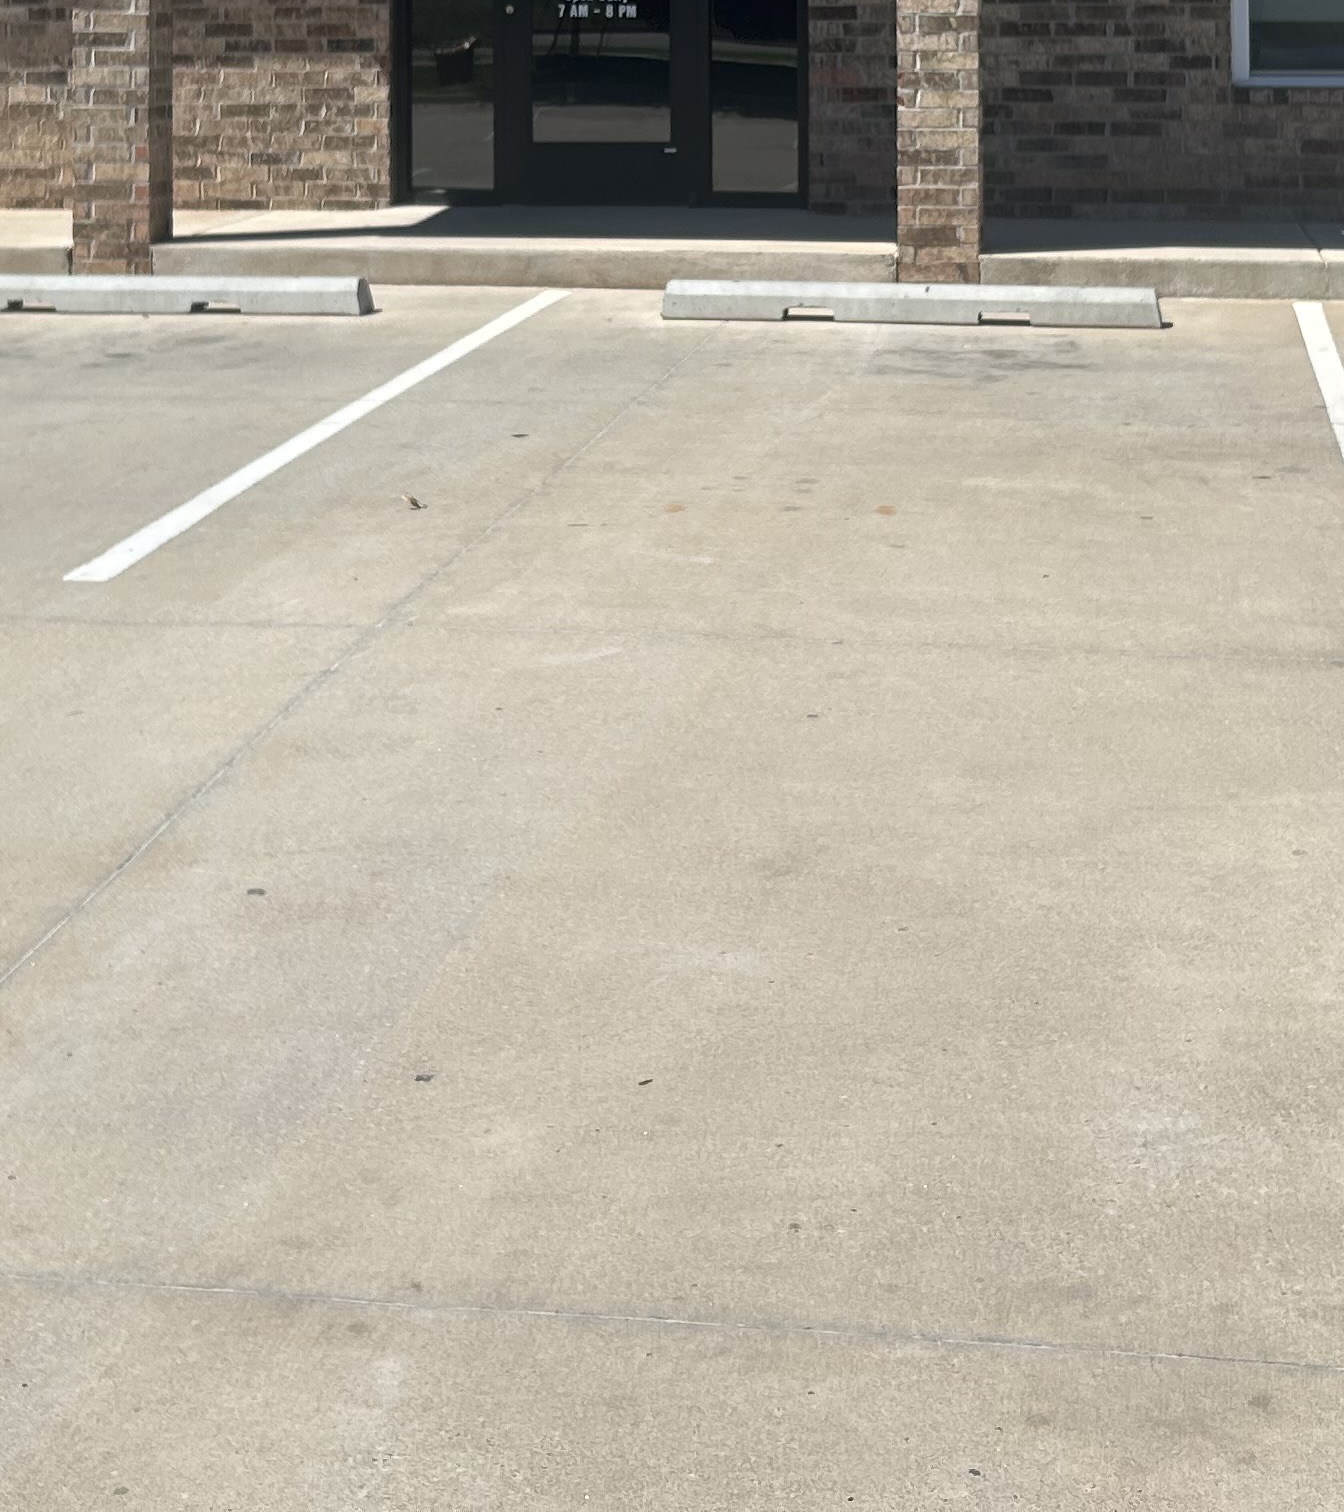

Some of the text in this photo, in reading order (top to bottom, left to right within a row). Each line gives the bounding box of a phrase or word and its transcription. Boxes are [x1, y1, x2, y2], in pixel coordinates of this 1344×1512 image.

[558, 4, 565, 18] 7
[570, 4, 589, 18] AM
[618, 4, 637, 18] PM
